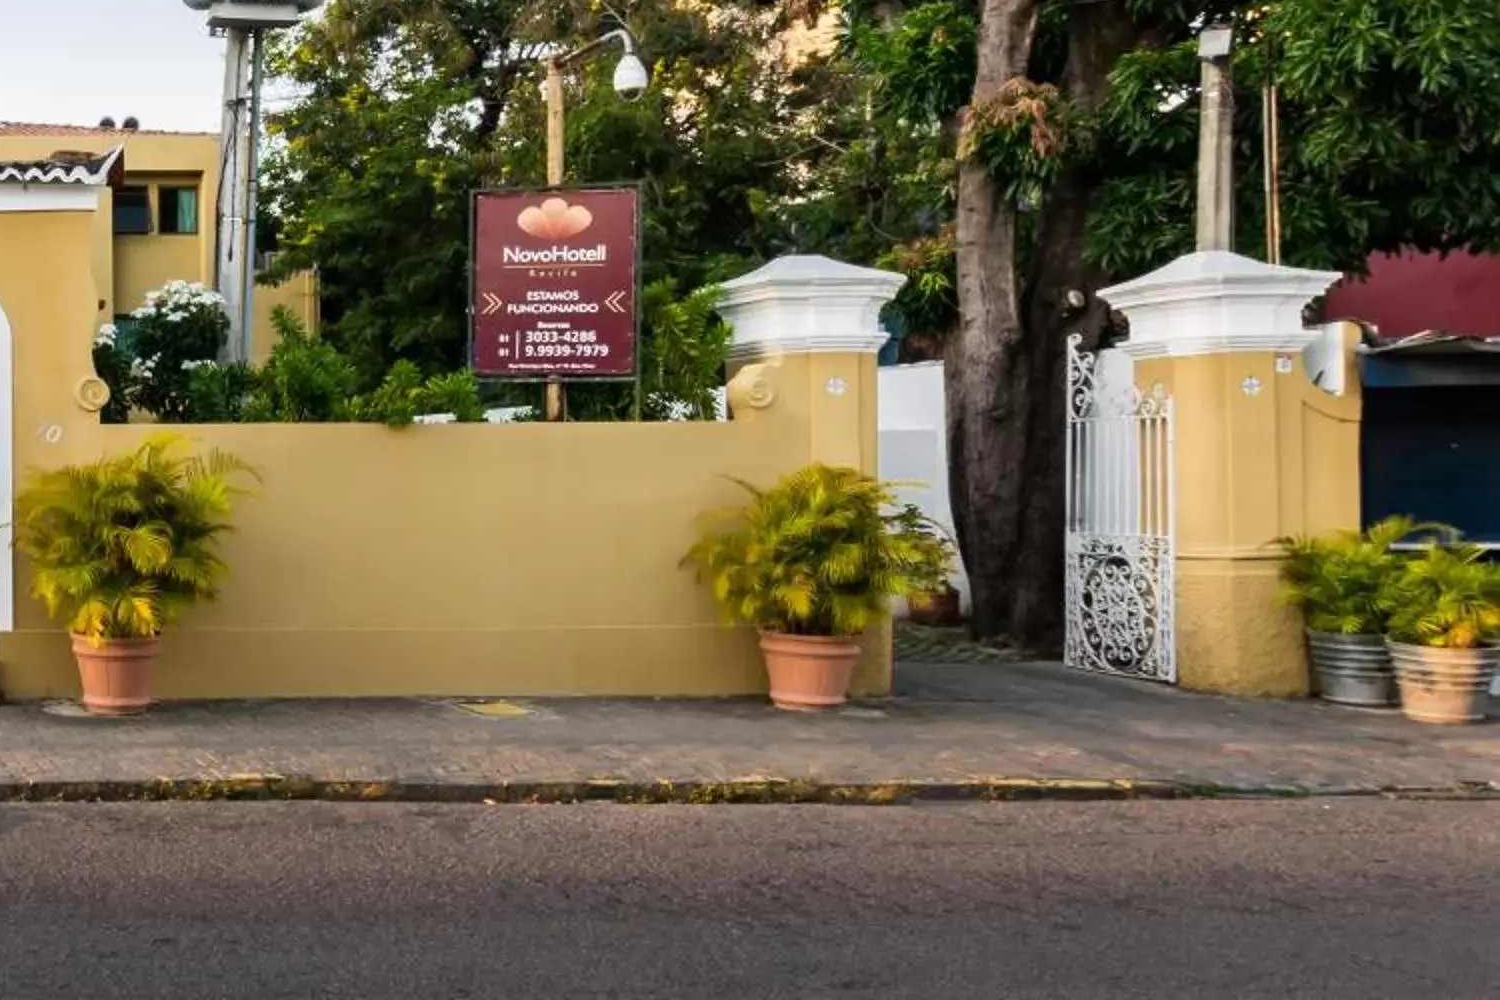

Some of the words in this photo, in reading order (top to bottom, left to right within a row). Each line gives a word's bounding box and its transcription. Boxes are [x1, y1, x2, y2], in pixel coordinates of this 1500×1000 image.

[503, 244, 606, 263] NovoHotell
[527, 290, 579, 301] ESTAMOS
[507, 303, 599, 314] FUNCIONANDO
[525, 330, 597, 343] 3033-4286
[525, 345, 609, 358] 9.9939-7979
